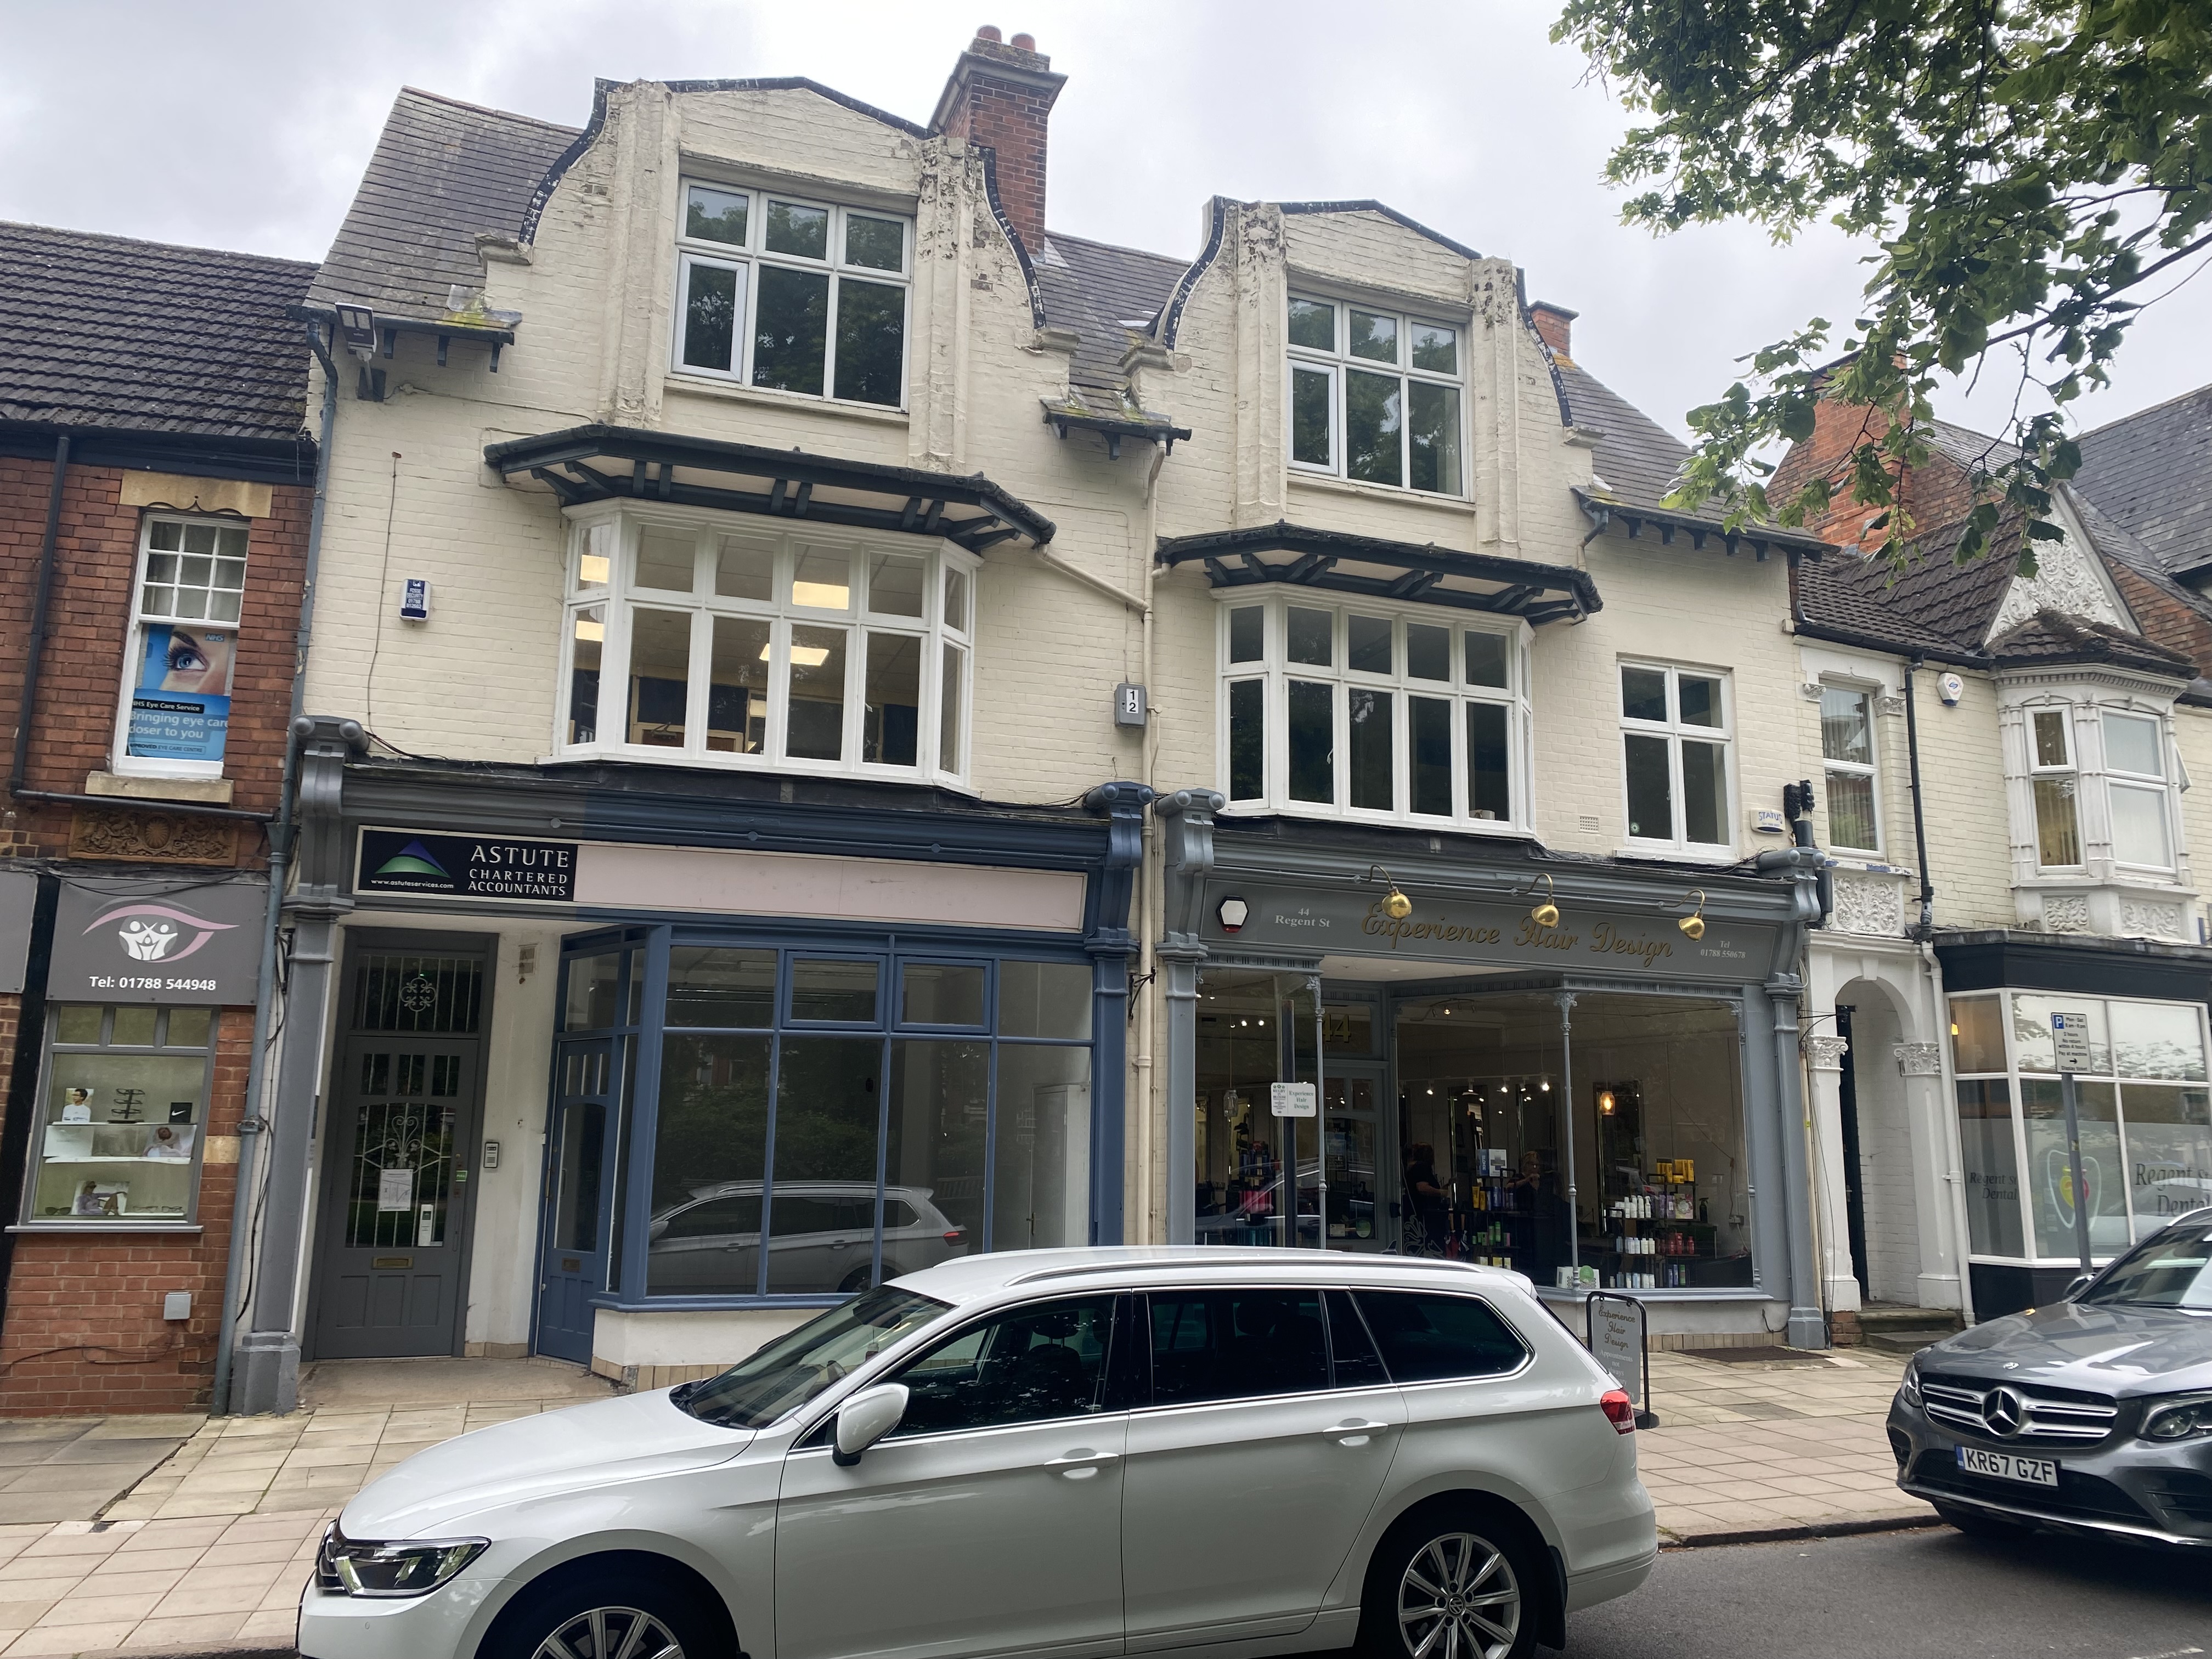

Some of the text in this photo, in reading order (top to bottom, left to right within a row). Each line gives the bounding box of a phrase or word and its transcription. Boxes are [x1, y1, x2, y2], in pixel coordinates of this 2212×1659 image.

[1130, 691, 1135, 700] 1
[1129, 702, 1136, 712] 2
[131, 711, 179, 726] Bringing
[183, 717, 204, 727] eye
[165, 727, 177, 736] to
[180, 730, 204, 739] you
[1759, 812, 1782, 824] STATUS
[471, 845, 569, 868] ASTUTE
[470, 868, 567, 884] CHARTERED
[371, 879, 454, 889] www.astuteservices.com
[468, 881, 566, 896] ACCOUNTANTS
[1274, 915, 1330, 927] Regent St
[1362, 903, 1673, 967] Experience Hair Design
[1700, 949, 1746, 959] 01788 550678
[89, 976, 216, 990] Tel: 01788 544948
[2056, 1017, 2063, 1028] P
[1970, 1172, 2006, 1186] Regent
[2136, 1163, 2192, 1191] Regent
[1983, 1188, 2017, 1200] Dental
[1599, 1305, 1635, 1323] Experience
[1607, 1321, 1626, 1335] Hair
[1605, 1333, 1629, 1351] Design
[1600, 1349, 1633, 1362] Appointments
[1966, 1449, 2052, 1482] KR67 GZF
